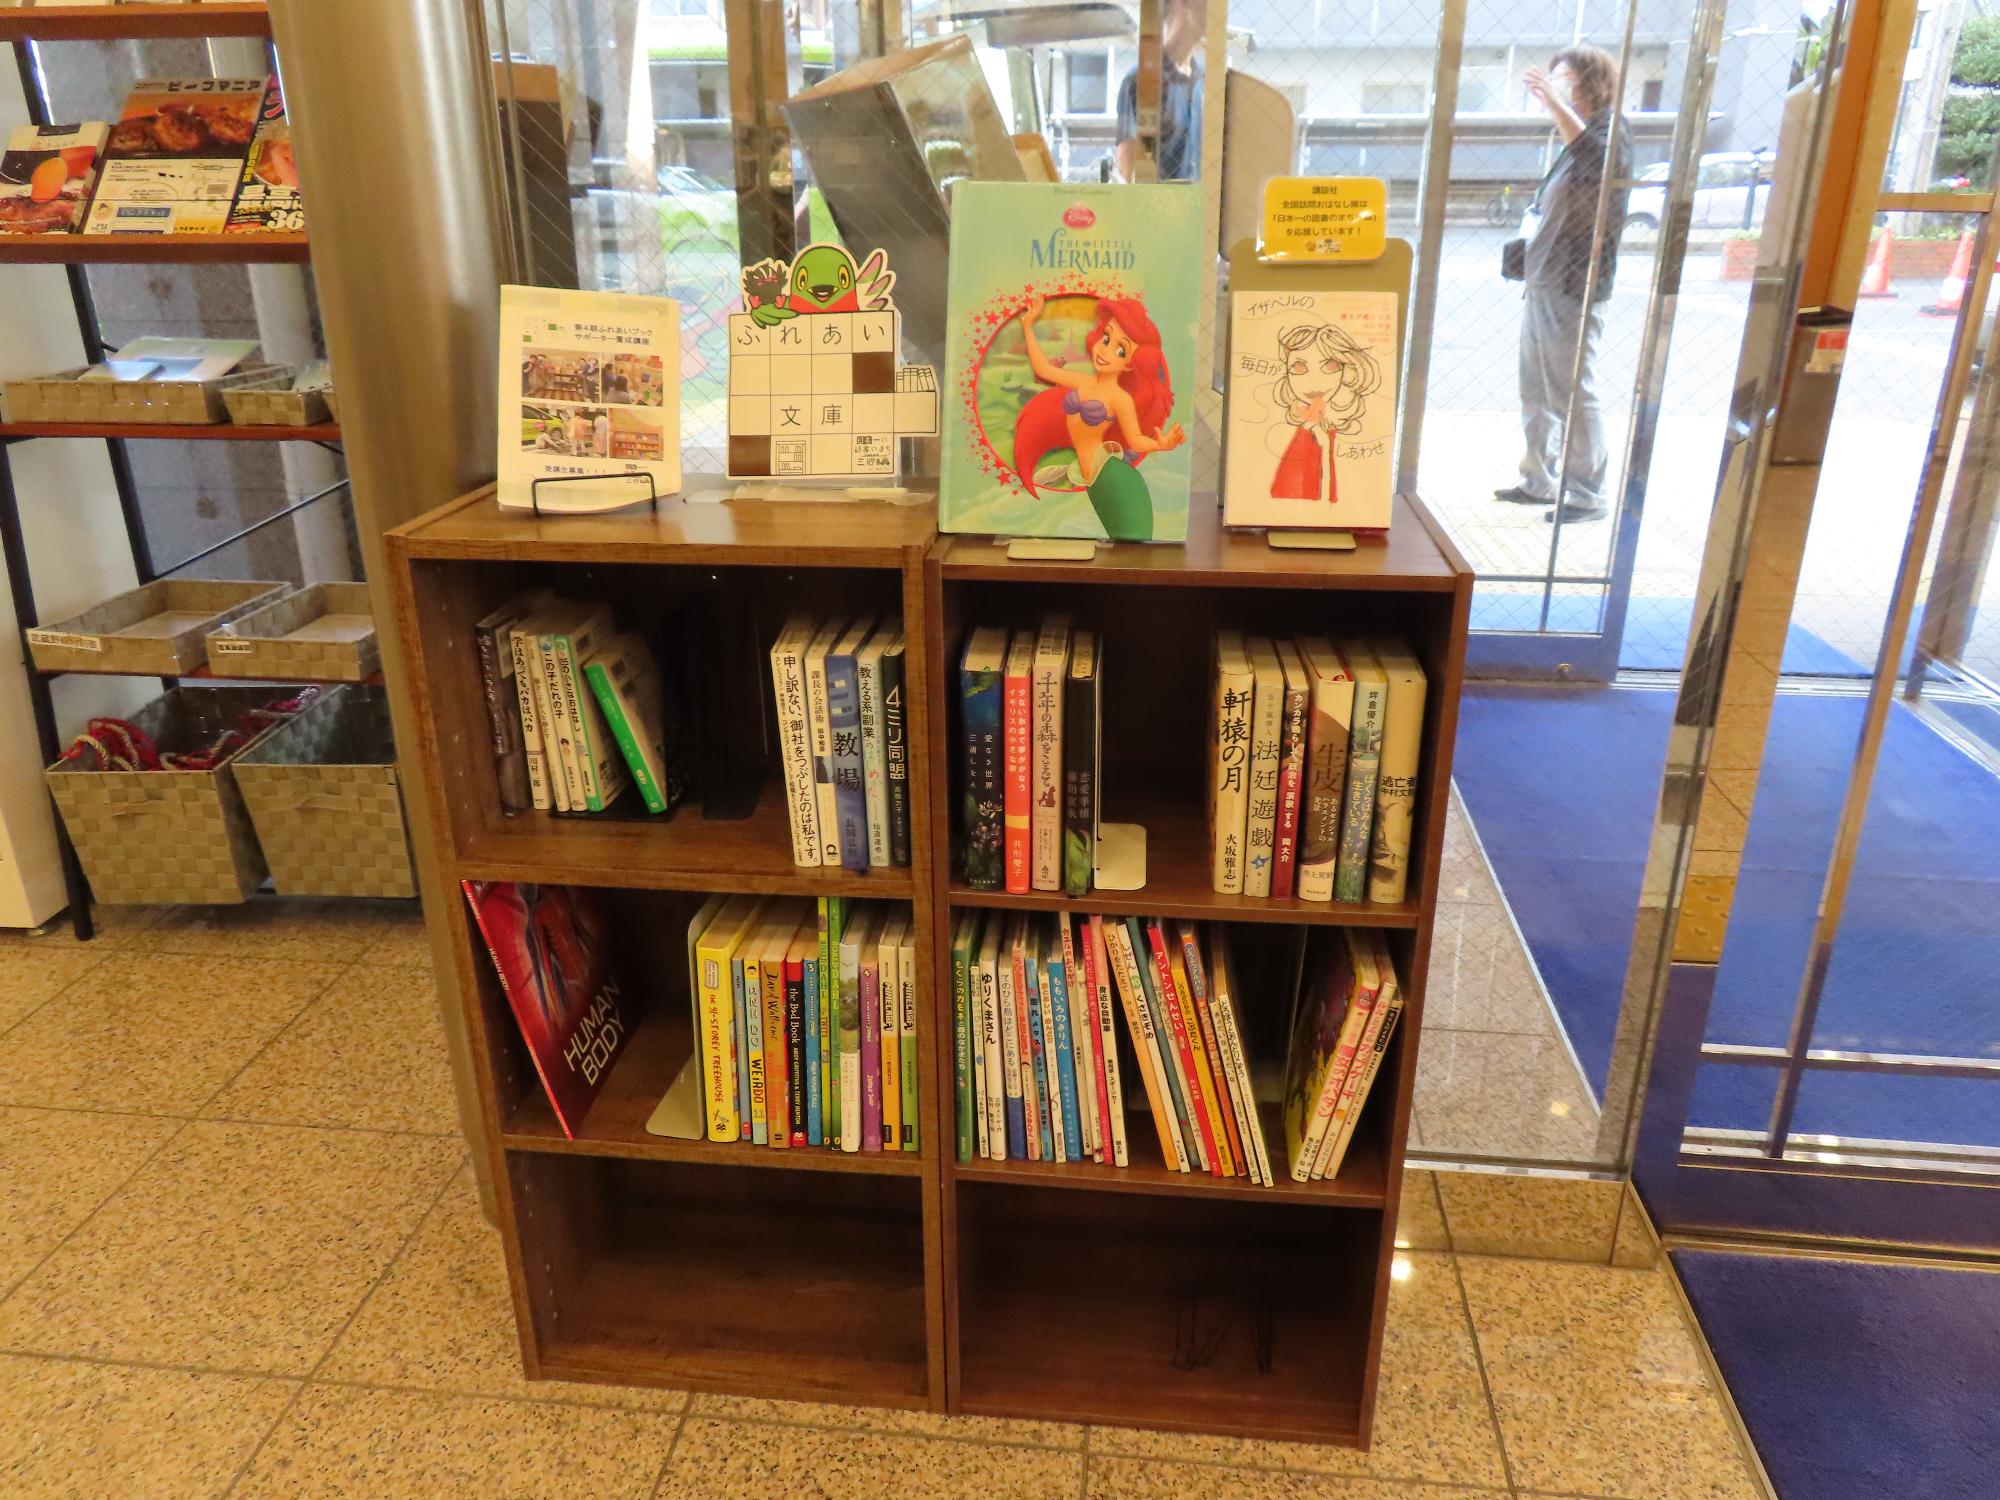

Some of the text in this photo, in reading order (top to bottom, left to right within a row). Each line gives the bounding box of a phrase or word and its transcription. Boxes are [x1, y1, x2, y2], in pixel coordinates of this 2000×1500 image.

[1282, 200, 1367, 209] 全国訪問おはなし隊は
[1312, 186, 1338, 195] 講談社
[1030, 228, 1135, 274] MERMAID
[1059, 240, 1132, 249] THE LITTLE
[1247, 295, 1315, 317] イザベルの
[737, 323, 885, 346] ふれあい
[1240, 354, 1282, 377] 毎日が
[780, 404, 843, 427] 文庫
[1335, 442, 1386, 459] しあわせ
[544, 653, 564, 720] この子だれの子
[811, 671, 824, 724] 課長の会話術
[886, 685, 906, 779] 4ミリ同盟
[1220, 687, 1251, 792] 軒猿の月
[783, 655, 818, 863] 申し訳ない、御社をつぶしたのは私です。
[834, 731, 864, 793] 教場
[1312, 743, 1345, 792] 生皮
[1382, 775, 1418, 788] 逃亡者
[1250, 740, 1280, 848] 法廷遊戯
[1349, 779, 1361, 827] 生きている
[1223, 833, 1237, 880] 火坂雅志
[764, 966, 779, 1000] David
[807, 962, 815, 973] 3
[864, 968, 872, 977] 4
[1155, 951, 1183, 1031] アントンせんせい
[563, 977, 624, 1072] HUMAN
[790, 1001, 800, 1020] Bad
[884, 982, 894, 1032] MINECRAFT
[904, 982, 915, 1031] MINECRAFT
[981, 974, 997, 1045] ゆりくまさん
[1053, 975, 1068, 1051] ももいろのきりん
[581, 1011, 625, 1087] BODY
[791, 1021, 801, 1044] Book
[711, 1054, 724, 1104] TREEHOUSE
